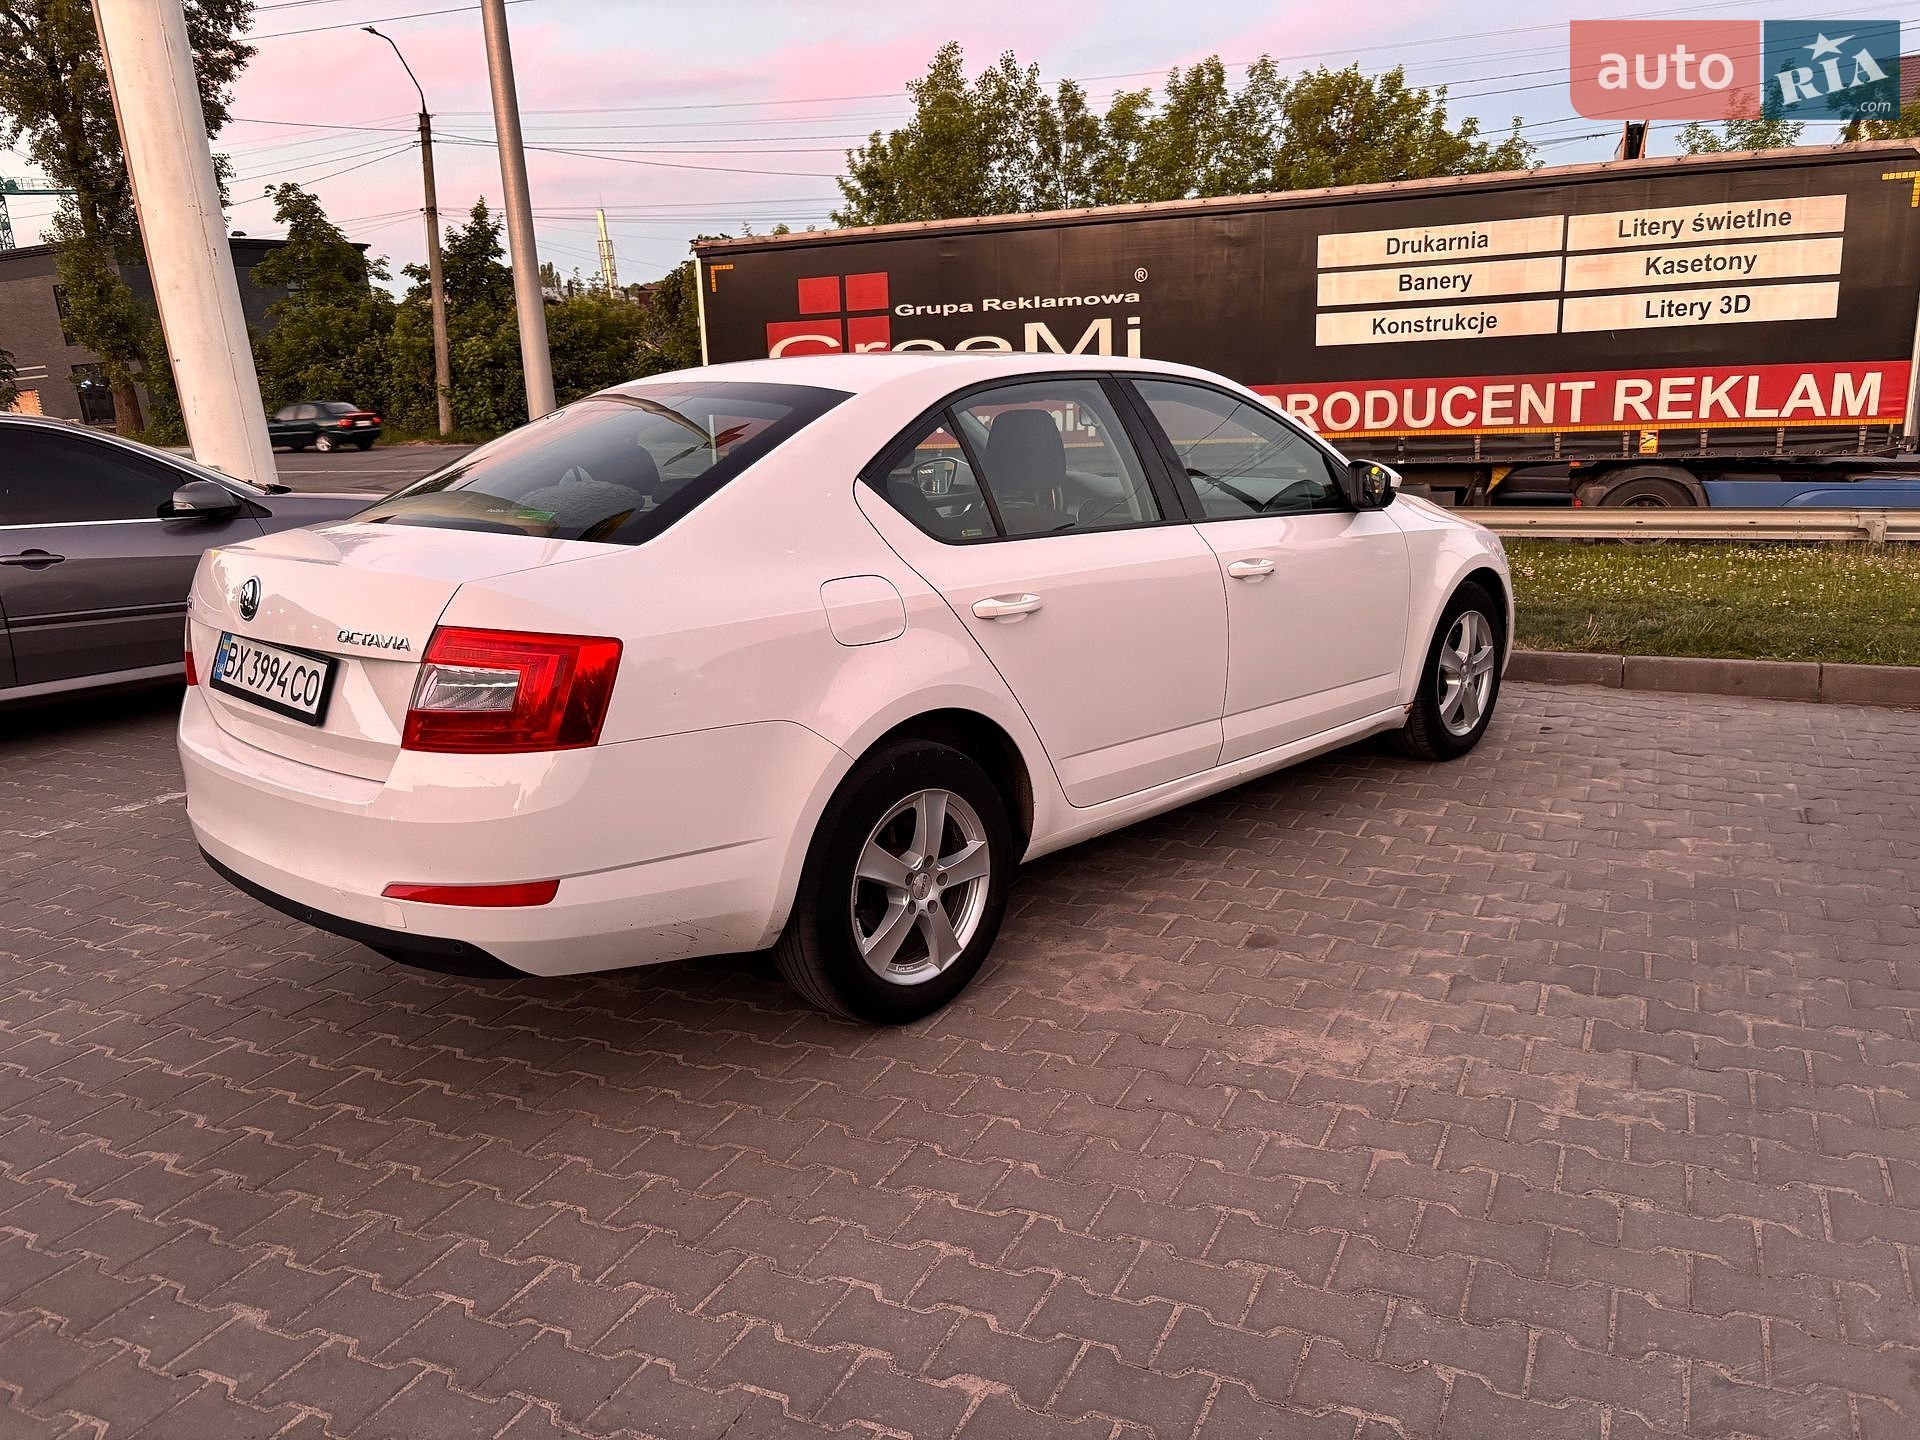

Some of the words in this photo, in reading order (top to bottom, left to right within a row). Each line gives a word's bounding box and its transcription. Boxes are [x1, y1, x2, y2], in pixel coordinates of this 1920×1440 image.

[1617, 214, 1685, 240] Litery
[1691, 208, 1792, 233] świetlne
[1385, 230, 1489, 255] Drukarnia
[1644, 251, 1758, 275] Kasetony
[1398, 271, 1473, 293] Banery
[894, 303, 974, 317] Grupa
[982, 292, 1141, 312] Reklamowa
[1644, 297, 1713, 320] Litery
[1719, 294, 1752, 315] 3D
[1371, 311, 1498, 336] Konstrukcje
[1613, 371, 1883, 422] REKLAM
[336, 629, 411, 652] OCTAVIA
[223, 643, 251, 682] BX
[248, 651, 292, 698] 3994
[290, 665, 321, 707] CO
